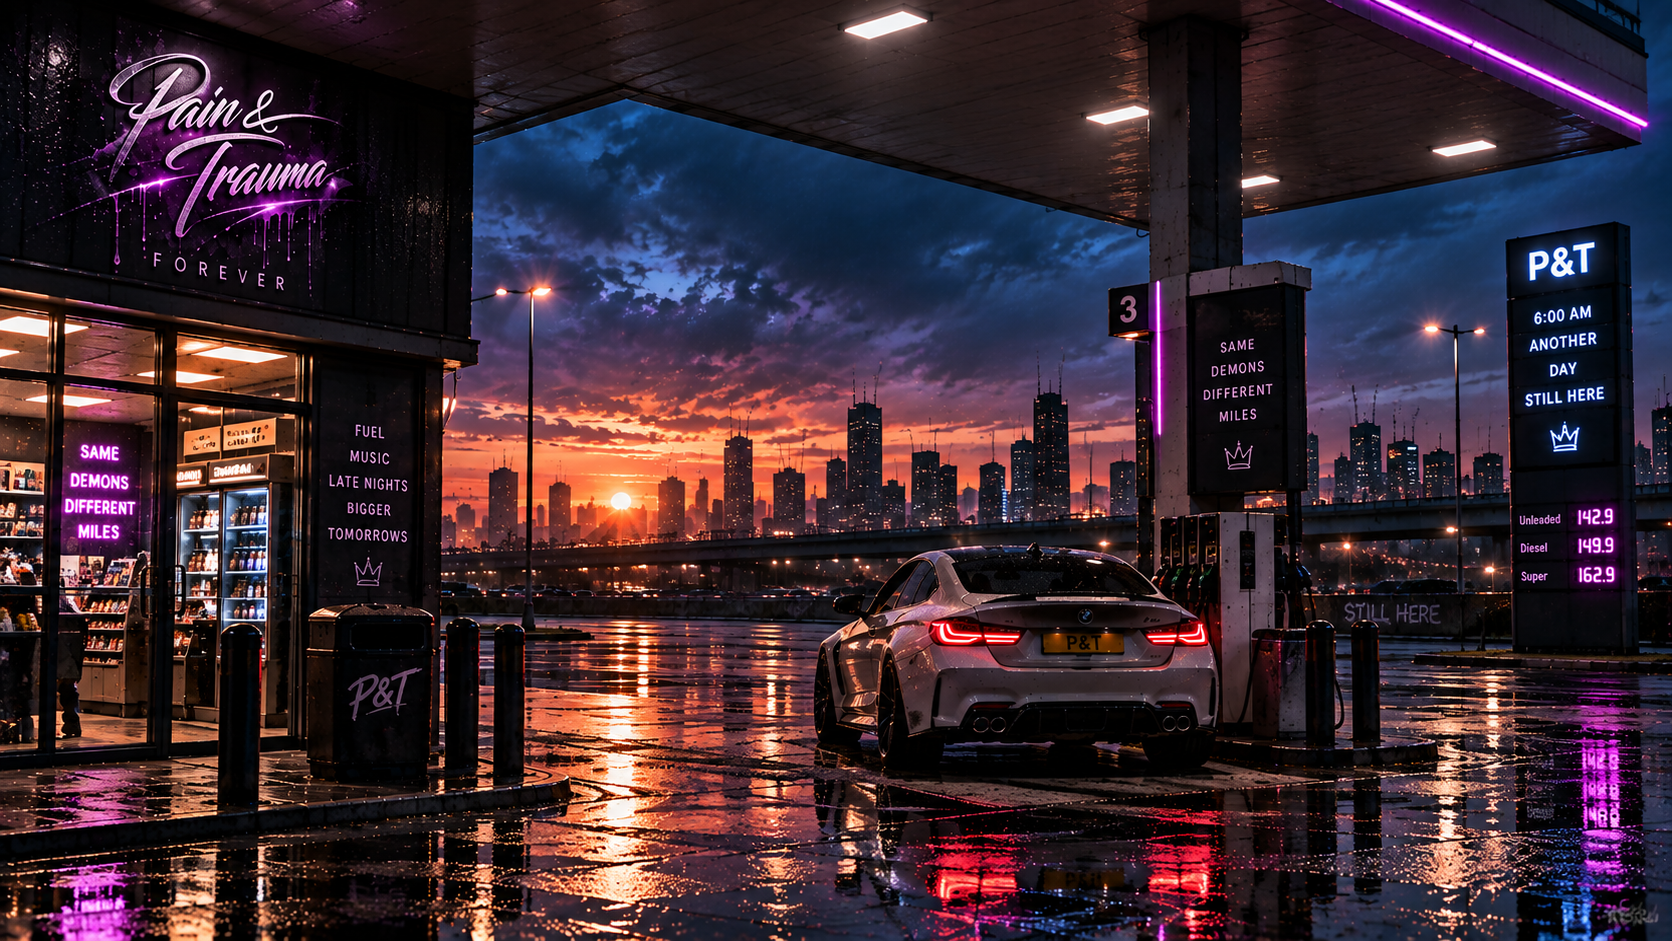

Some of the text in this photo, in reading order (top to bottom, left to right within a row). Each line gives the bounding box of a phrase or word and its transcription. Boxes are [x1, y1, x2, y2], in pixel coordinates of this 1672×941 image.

[109, 53, 242, 183] Pain
[164, 132, 328, 238] Trauma
[1527, 241, 1595, 282] P&T
[153, 252, 286, 291] FOREVER
[1119, 294, 1138, 324] 3
[1533, 304, 1592, 325] 6:00 AM
[1220, 338, 1255, 353] SAME
[1529, 331, 1597, 352] ANOTHER
[1210, 361, 1265, 378] DEMONS
[1549, 361, 1577, 378] DAY
[1203, 383, 1273, 401] DIFFERENT
[1524, 386, 1605, 407] STILL HERE
[1219, 407, 1257, 422] MILES
[354, 424, 385, 439] FUEL
[80, 444, 119, 462] SAME
[350, 450, 390, 466] MUSIC
[70, 473, 129, 491] DEMONS
[329, 475, 409, 493] LATE NIGHTS
[64, 499, 135, 516] DIFFERENT
[346, 501, 391, 517] BIGGER
[1519, 509, 1614, 526] Unleaded 142.9
[78, 524, 120, 540] MILES
[328, 527, 408, 543] TOMORROWS
[1520, 537, 1614, 554] Diesel 149.9
[1520, 566, 1615, 584] Super 162.9
[1344, 602, 1442, 625] STILL HERE
[1066, 635, 1101, 651] P&T
[347, 666, 423, 722] P&T
